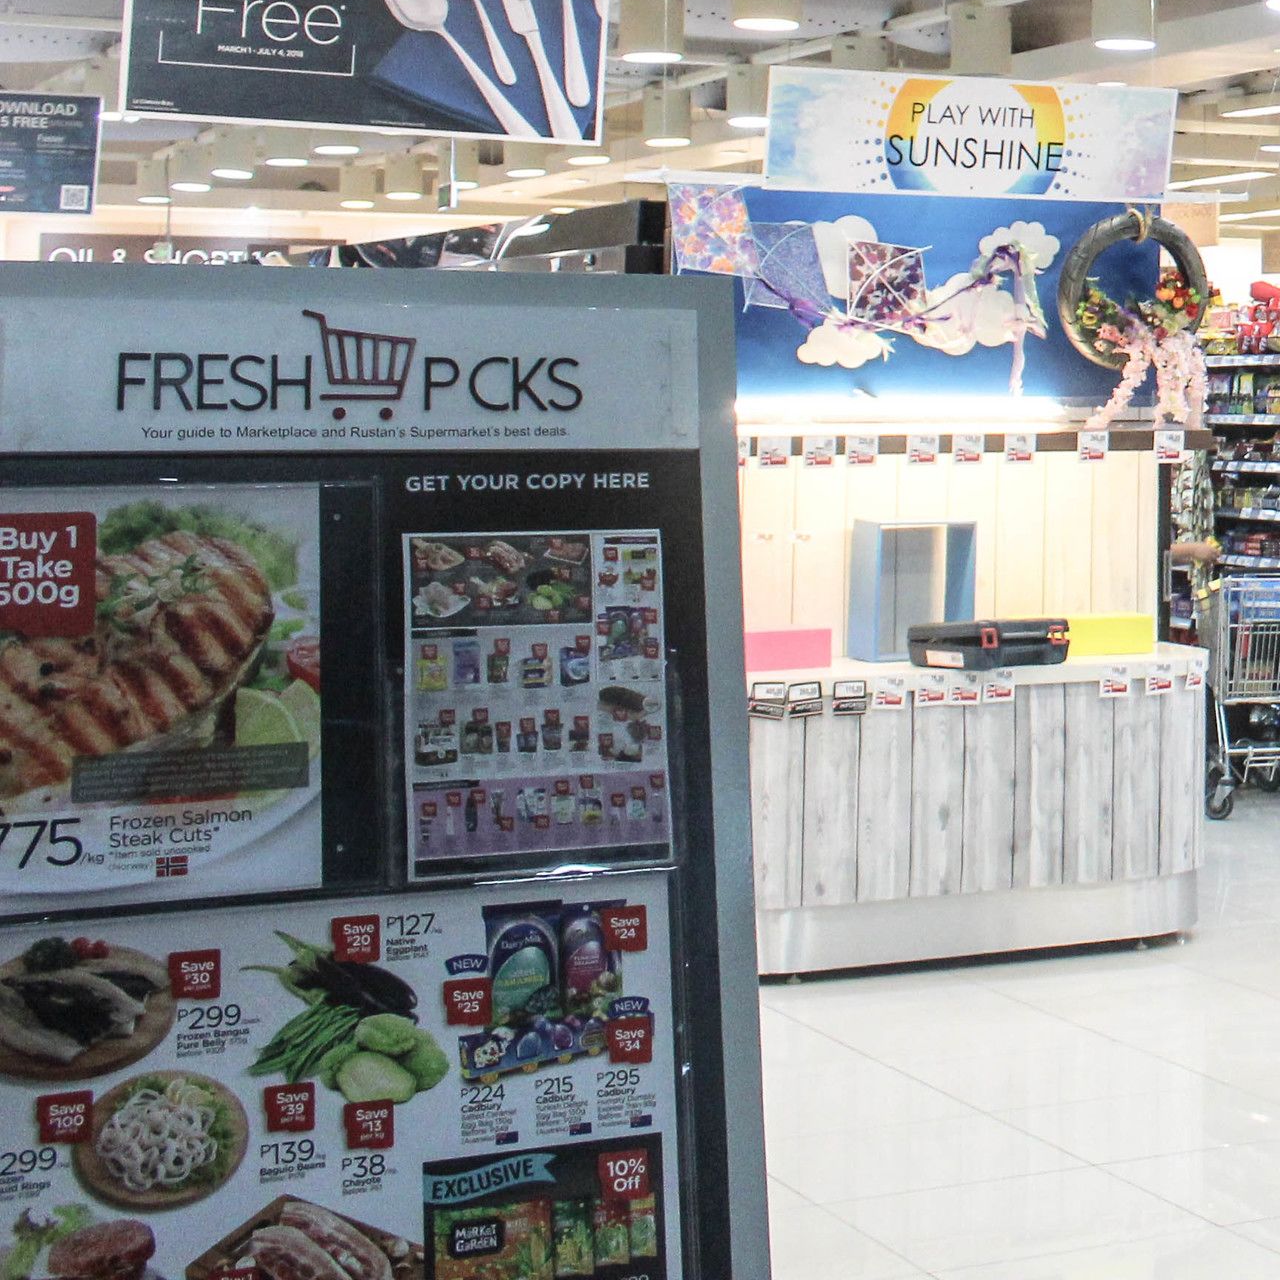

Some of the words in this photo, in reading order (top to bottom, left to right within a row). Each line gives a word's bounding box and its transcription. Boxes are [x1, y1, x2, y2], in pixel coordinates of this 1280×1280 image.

[217, 44, 246, 54] MARCH
[12, 116, 48, 129] FREE
[911, 101, 973, 128] PLAY
[978, 105, 1036, 130] WITH
[886, 134, 1066, 174] SUNSHINE
[117, 352, 313, 411] FRESH
[142, 427, 173, 439] Your
[177, 426, 215, 441] guide
[220, 428, 232, 439] to
[236, 426, 317, 441] Marketplace
[321, 426, 346, 438] and
[350, 426, 406, 438] Rustan's
[410, 426, 500, 440] Supermarket's
[504, 426, 531, 437] best
[405, 475, 450, 492] GET
[457, 474, 519, 491] YOUR
[526, 473, 586, 490] COPY
[593, 472, 650, 489] HERE
[0, 525, 58, 554] Buy
[65, 525, 78, 549] 1
[2, 555, 73, 579] Take
[0, 582, 80, 608] 500g
[109, 813, 178, 831] Frozen
[182, 808, 252, 826] Salmon
[109, 829, 164, 848] Steak
[343, 923, 375, 935] Save
[610, 916, 641, 928] Save
[386, 937, 416, 947] Native
[386, 944, 429, 956] Eggplant
[181, 960, 215, 972] Save
[452, 959, 483, 971] NEW
[453, 990, 484, 1002] Save
[614, 1001, 644, 1012] NEW
[176, 1032, 211, 1042] Frozen
[214, 1027, 250, 1039] Bangus
[615, 1028, 645, 1040] Save
[176, 1041, 200, 1051] Pure
[202, 1038, 227, 1050] Belly
[276, 1092, 309, 1104] Save
[49, 1103, 85, 1117] Save
[356, 1108, 388, 1122] Save
[461, 1102, 502, 1114] Cadbury
[606, 1157, 646, 1178] 10%
[342, 1177, 382, 1189] Chayote
[432, 1156, 534, 1201] EXCLUSIVE
[613, 1174, 641, 1193] Off
